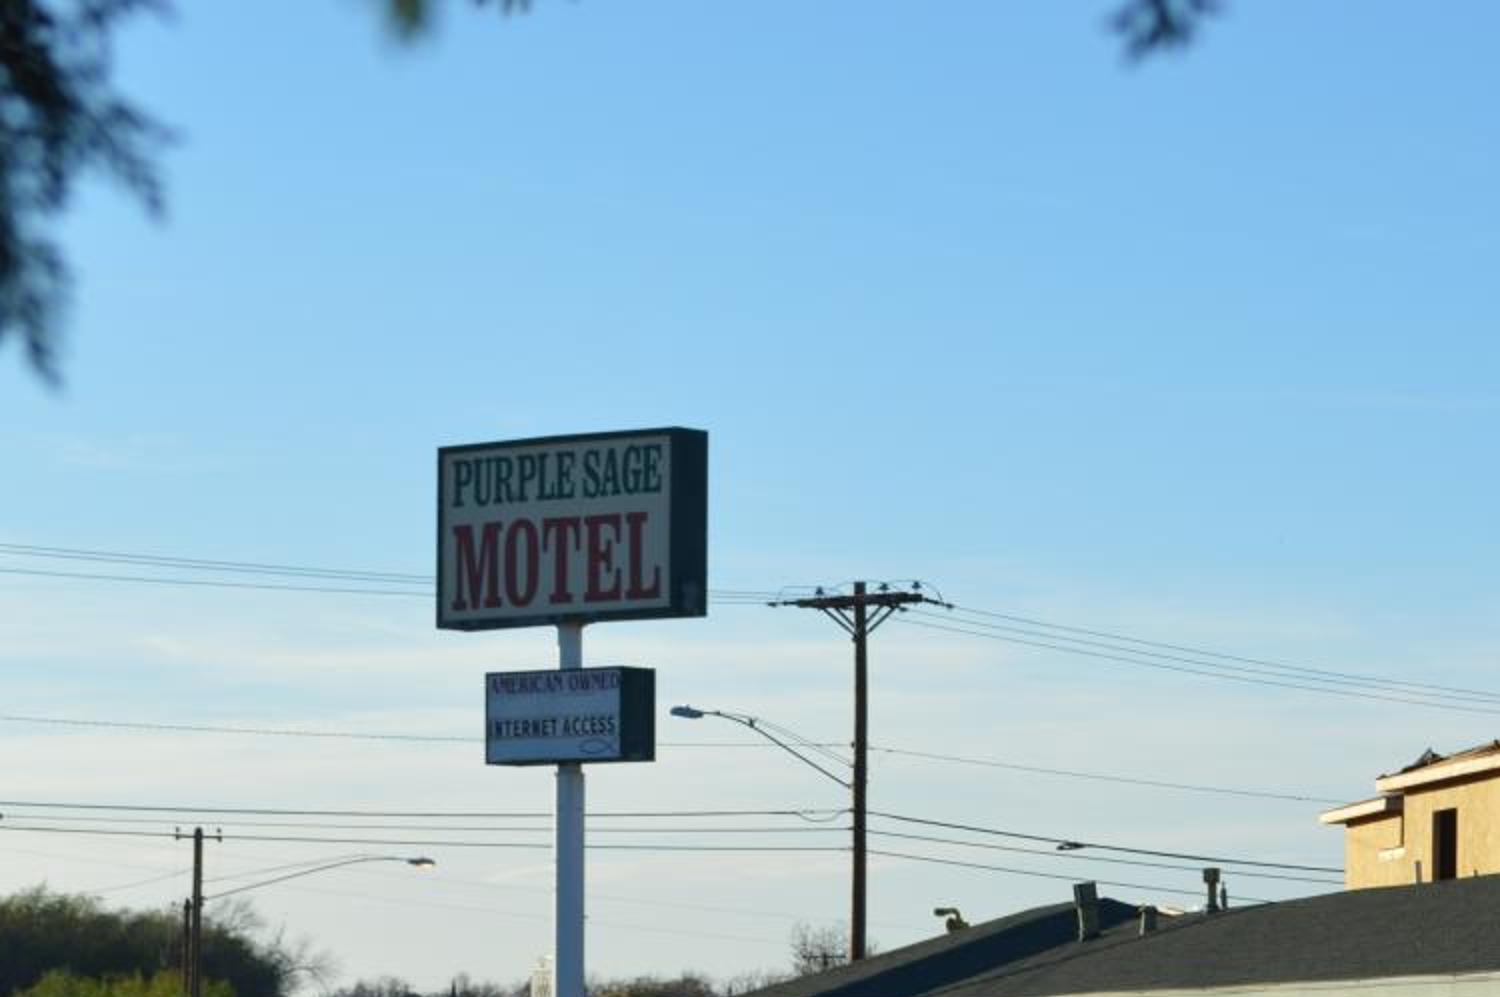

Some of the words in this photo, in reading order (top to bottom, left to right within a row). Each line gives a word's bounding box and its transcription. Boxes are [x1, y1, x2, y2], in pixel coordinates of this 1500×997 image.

[452, 451, 576, 508] PURPLE
[583, 444, 663, 498] SAGE
[452, 511, 661, 611] MOTEL
[563, 713, 617, 737] ACCESS
